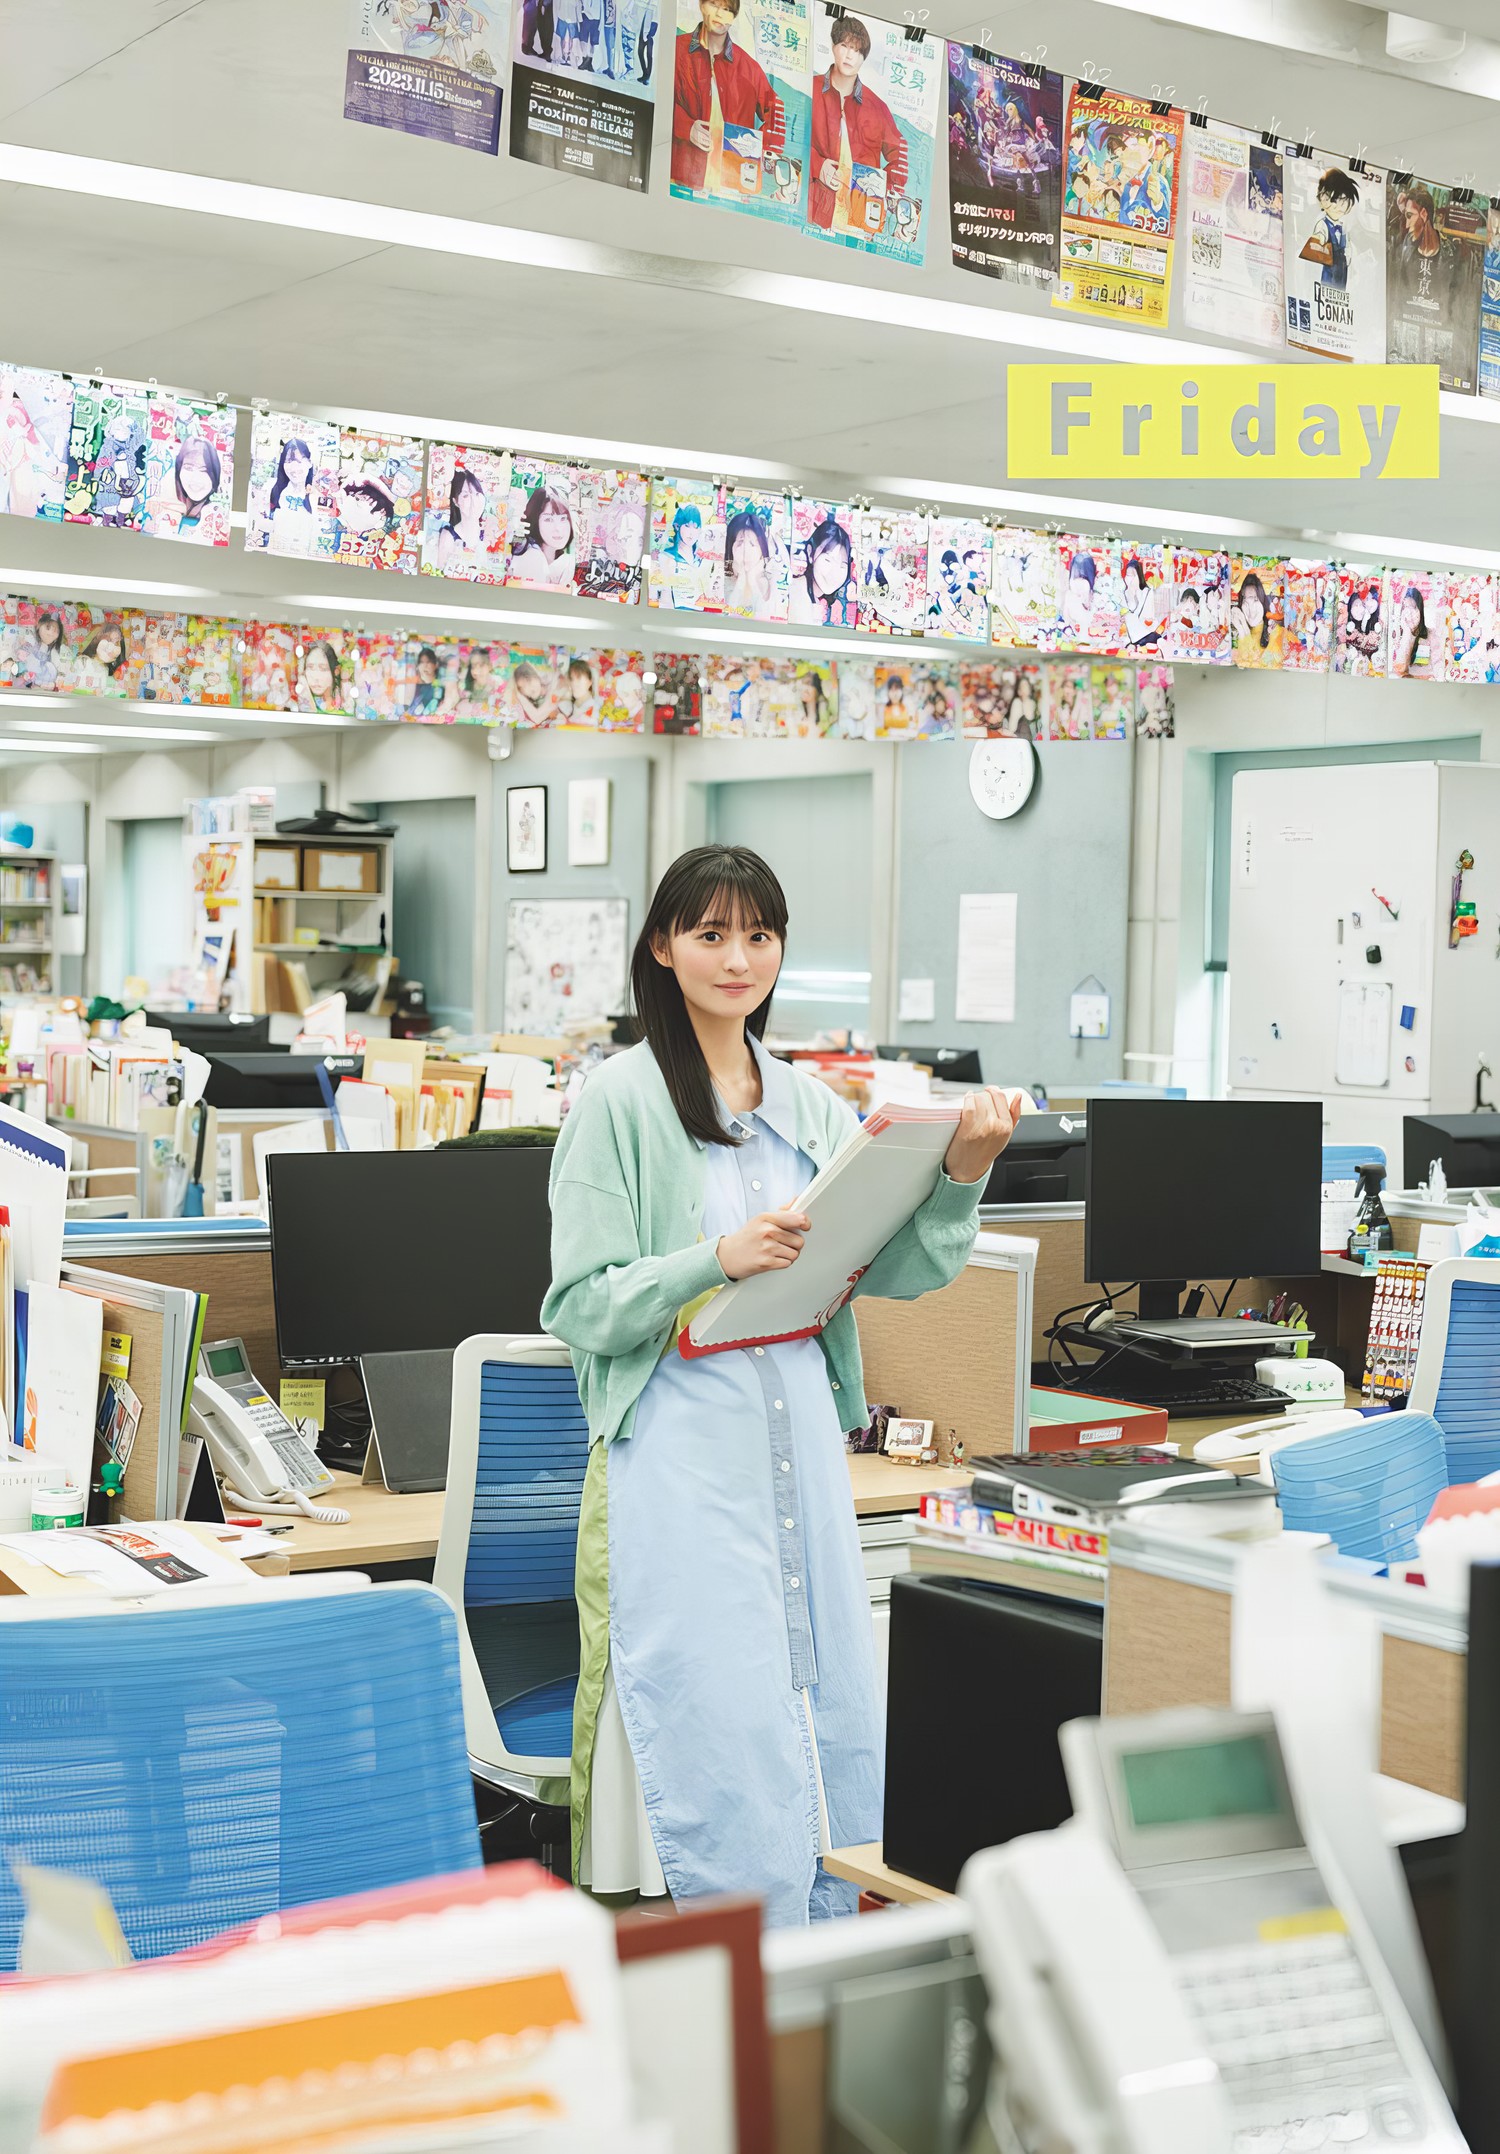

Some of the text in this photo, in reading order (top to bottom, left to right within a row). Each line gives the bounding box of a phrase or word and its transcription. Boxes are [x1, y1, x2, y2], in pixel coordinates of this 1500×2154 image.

[368, 66, 444, 99] 2023.11.15
[528, 99, 588, 127] Proxima
[590, 118, 634, 139] RELEASE
[957, 222, 1055, 245] ギリギリアクションRPG
[1417, 258, 1433, 296] 東京
[1317, 301, 1354, 327] CONAN
